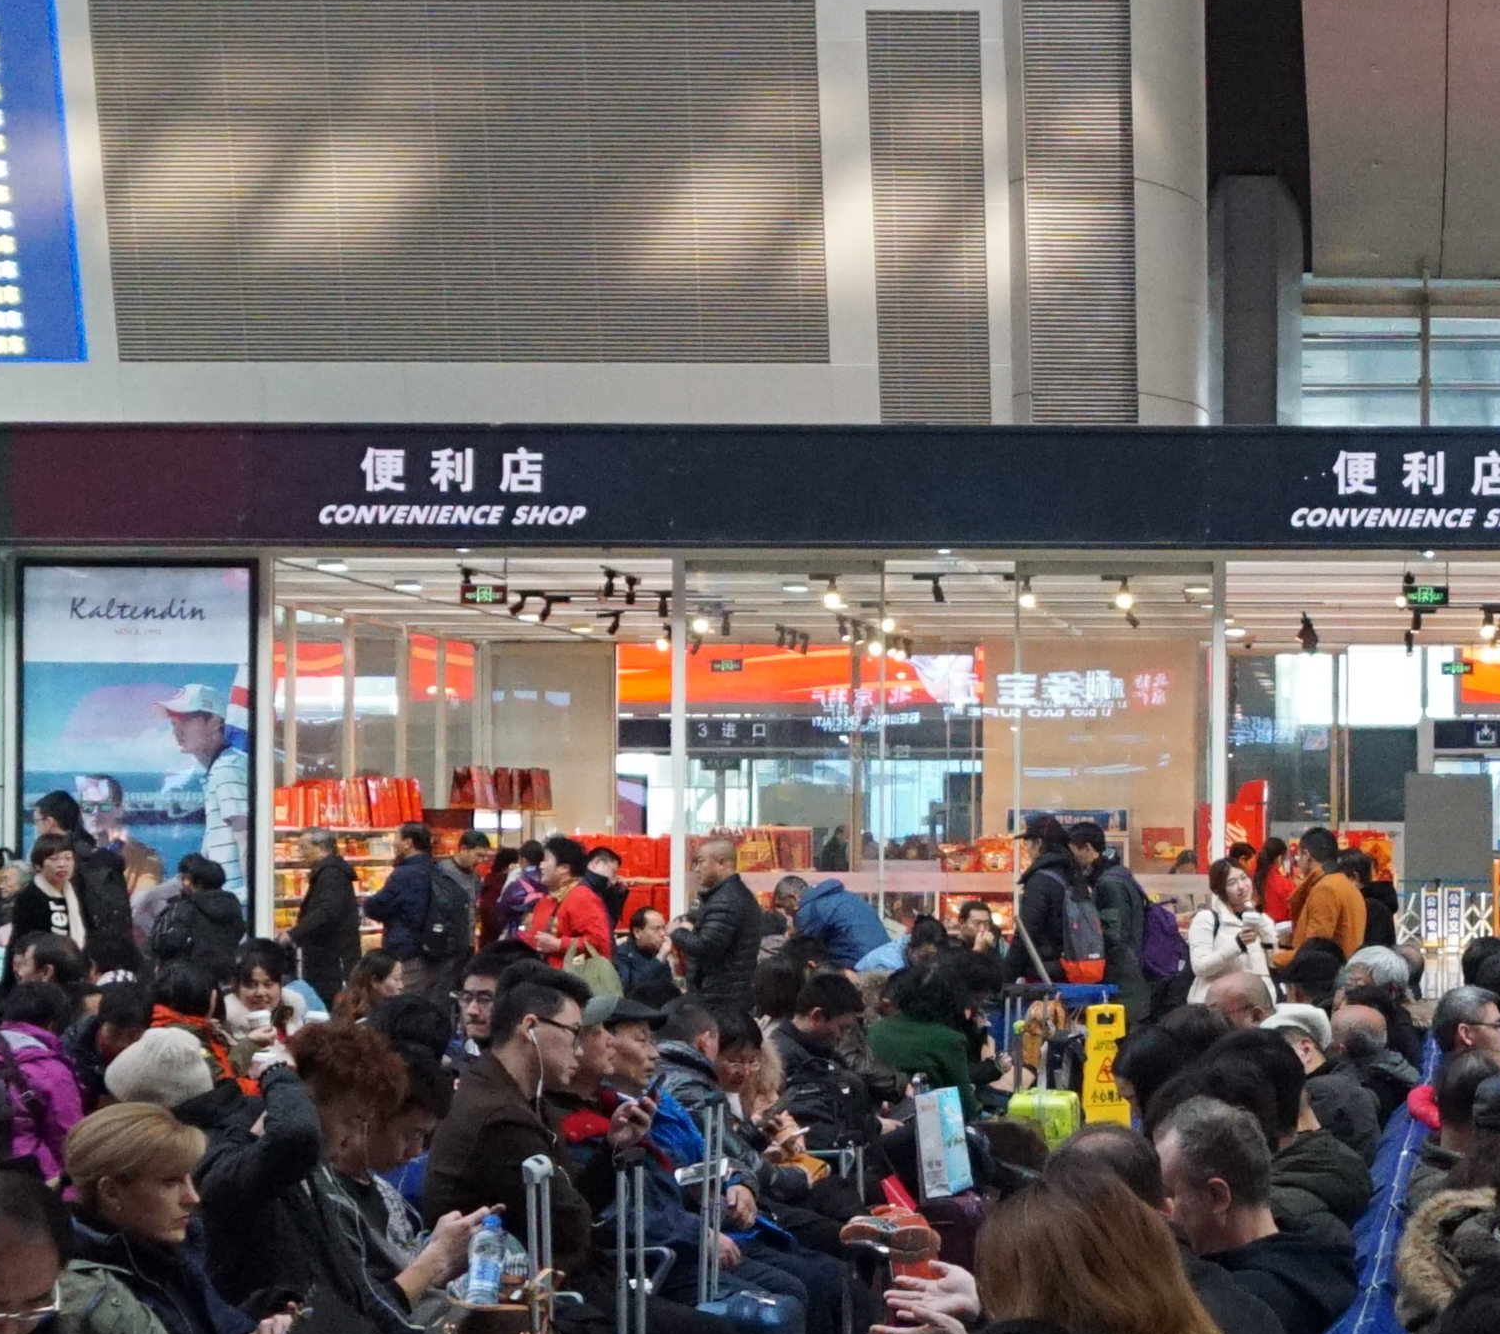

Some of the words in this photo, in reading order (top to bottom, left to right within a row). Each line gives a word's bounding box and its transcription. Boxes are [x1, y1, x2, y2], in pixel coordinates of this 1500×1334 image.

[361, 447, 544, 493] 便利店
[318, 504, 505, 526] CONVENIENCE
[510, 504, 587, 526] SHOP
[1290, 507, 1476, 529] CONVENIENCE
[70, 596, 206, 621] Kaltendin
